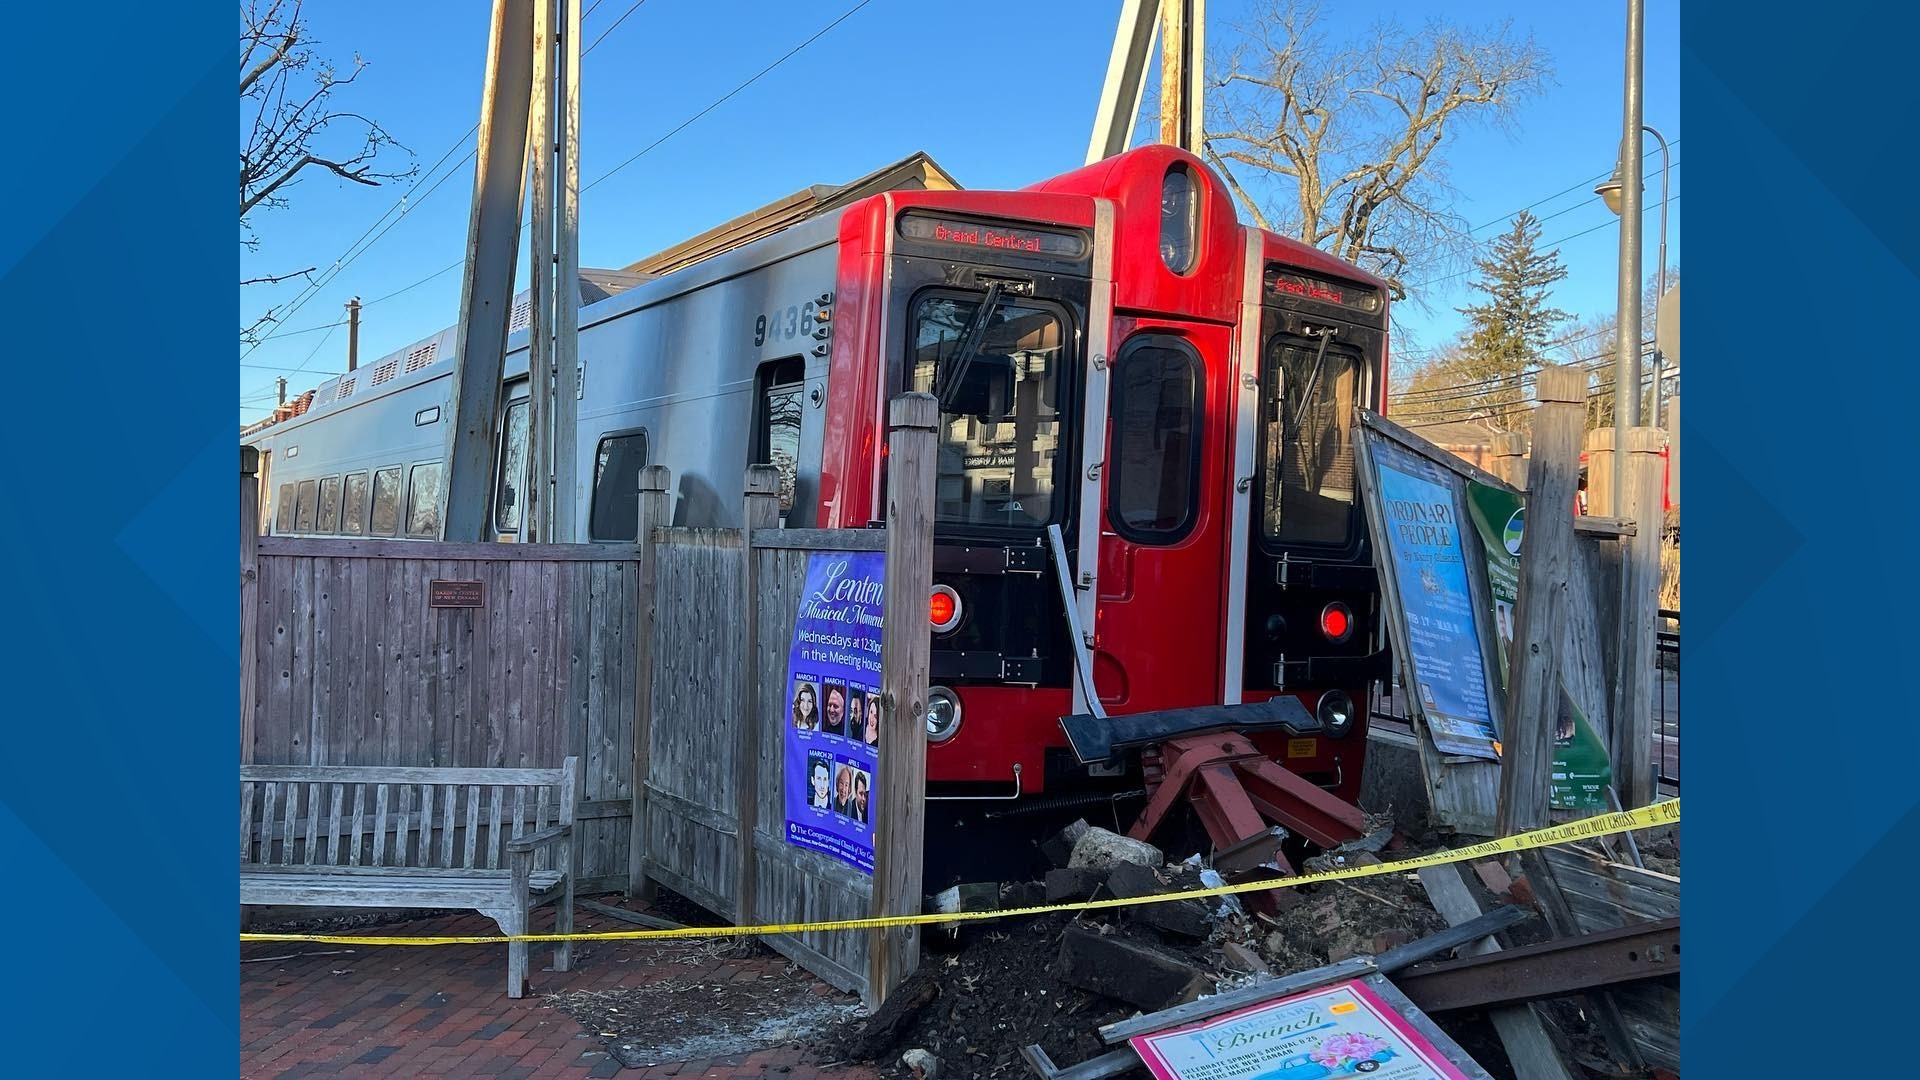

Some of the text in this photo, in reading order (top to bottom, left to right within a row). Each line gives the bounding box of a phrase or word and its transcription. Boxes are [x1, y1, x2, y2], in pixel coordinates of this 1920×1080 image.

[935, 224, 1041, 252] Grand Central
[754, 301, 814, 347] 9436
[1385, 499, 1453, 525] ORDINARY
[1399, 523, 1453, 547] PEOPLE
[813, 560, 884, 606] Lenten
[800, 600, 884, 628] Musical Moment
[798, 629, 852, 650] Wednesdays
[853, 638, 860, 648] at
[801, 648, 882, 673] in the Meeting House
[796, 673, 813, 681] MARCH
[809, 749, 826, 758] MARCH
[797, 825, 807, 835] The
[1529, 830, 1558, 844] POLICE
[1558, 824, 1578, 839] LINE
[1608, 811, 1637, 829] CROSS
[1218, 1011, 1320, 1053] Brunch
[1181, 1060, 1225, 1075] CELEBRATE
[1227, 1049, 1263, 1064] SPRING'S
[1265, 1042, 1298, 1055] ARRIVAL
[1185, 1049, 1295, 1080] YEARS OF THE NEW CANAAN
[1229, 1065, 1262, 1077] MARKET
